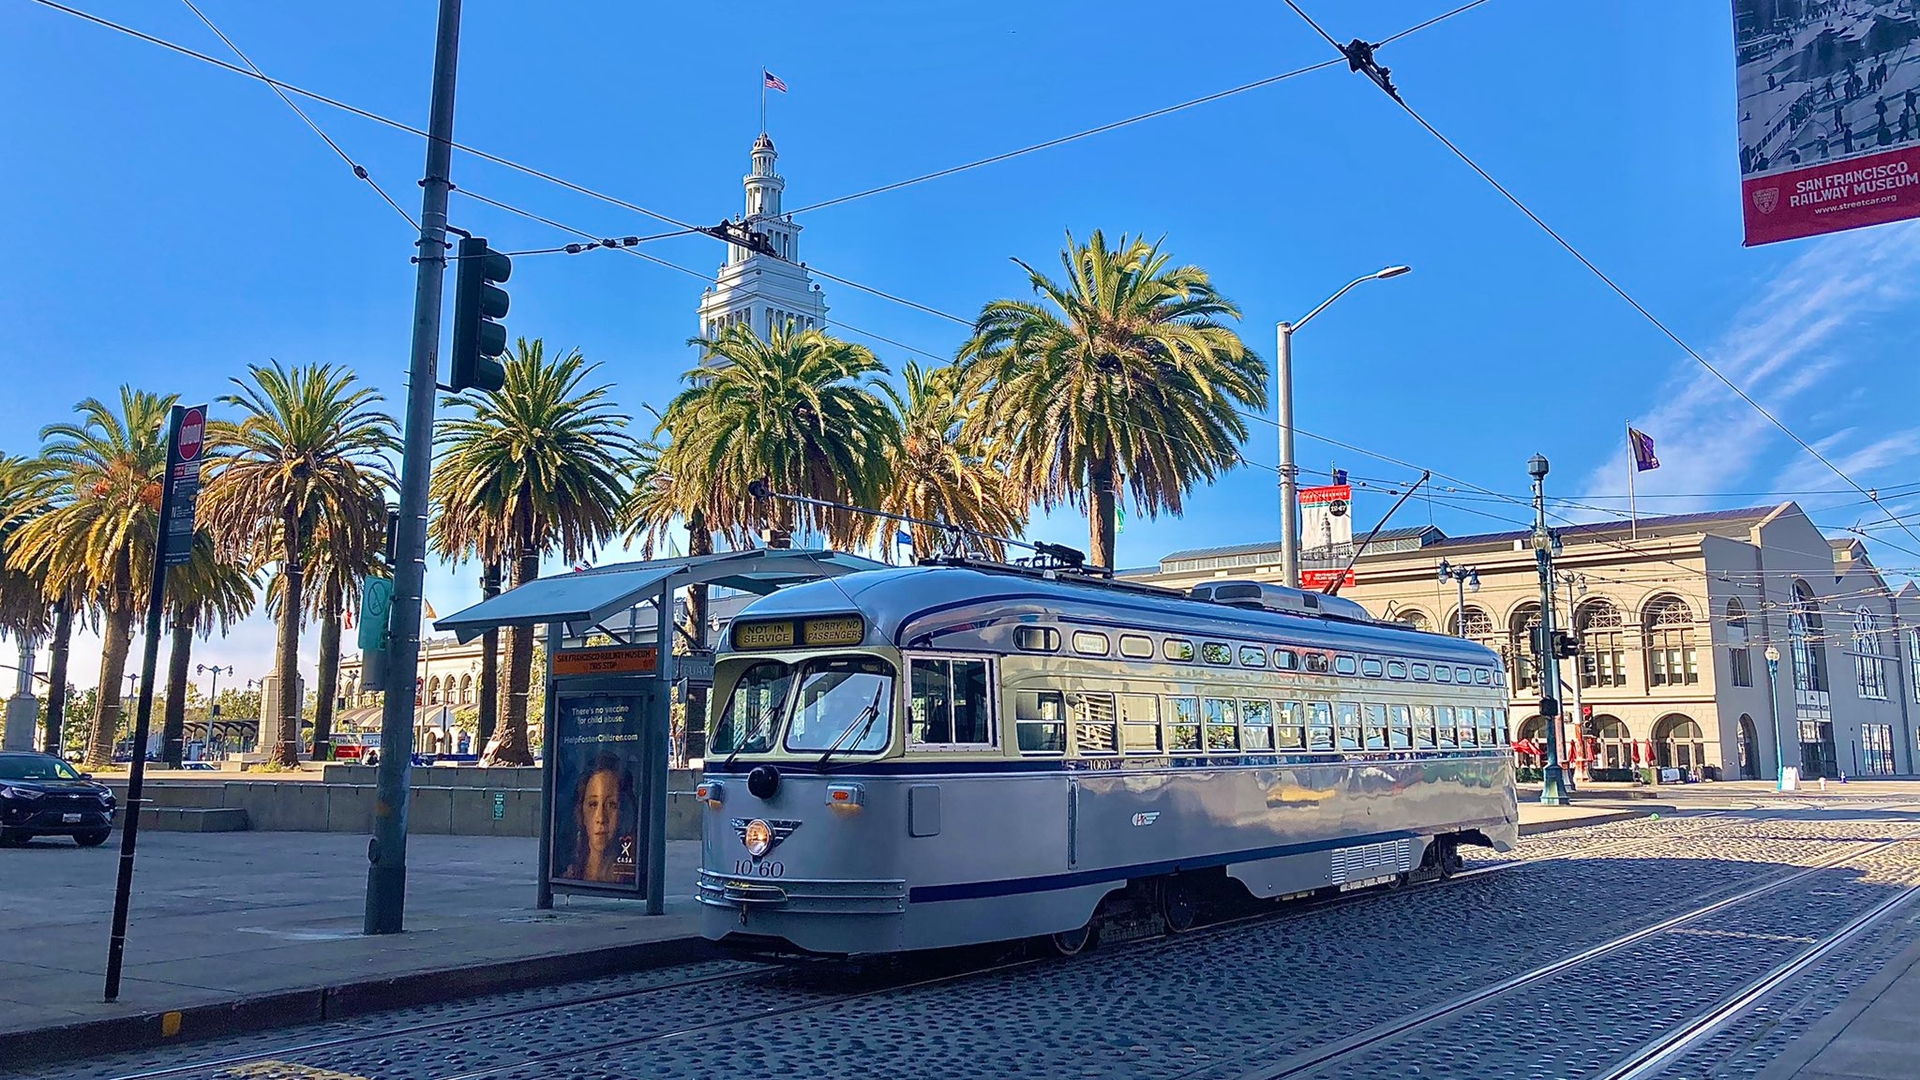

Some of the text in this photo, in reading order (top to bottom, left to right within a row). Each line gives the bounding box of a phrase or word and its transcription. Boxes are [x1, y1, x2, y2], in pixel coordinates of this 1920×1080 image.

[1796, 161, 1909, 193] SAN FRANCISCO
[1789, 185, 1849, 208] RAILWAY
[1853, 172, 1919, 196] MUSEUM
[1814, 194, 1897, 214] www.streetcar.org
[747, 624, 785, 635] NOT IN
[812, 620, 859, 631] SORRY, NO
[743, 633, 790, 643] SERVICE
[807, 629, 862, 641] PASSENGERS
[568, 653, 600, 662] FRANCISCO
[624, 650, 650, 659] MUSEUM
[589, 661, 617, 670] THIS STOP
[572, 704, 629, 716] There's no vaccine
[577, 717, 587, 725] for
[587, 715, 603, 724] child
[564, 734, 638, 744] HelpFosterChildren.com
[1090, 759, 1110, 770] 1060
